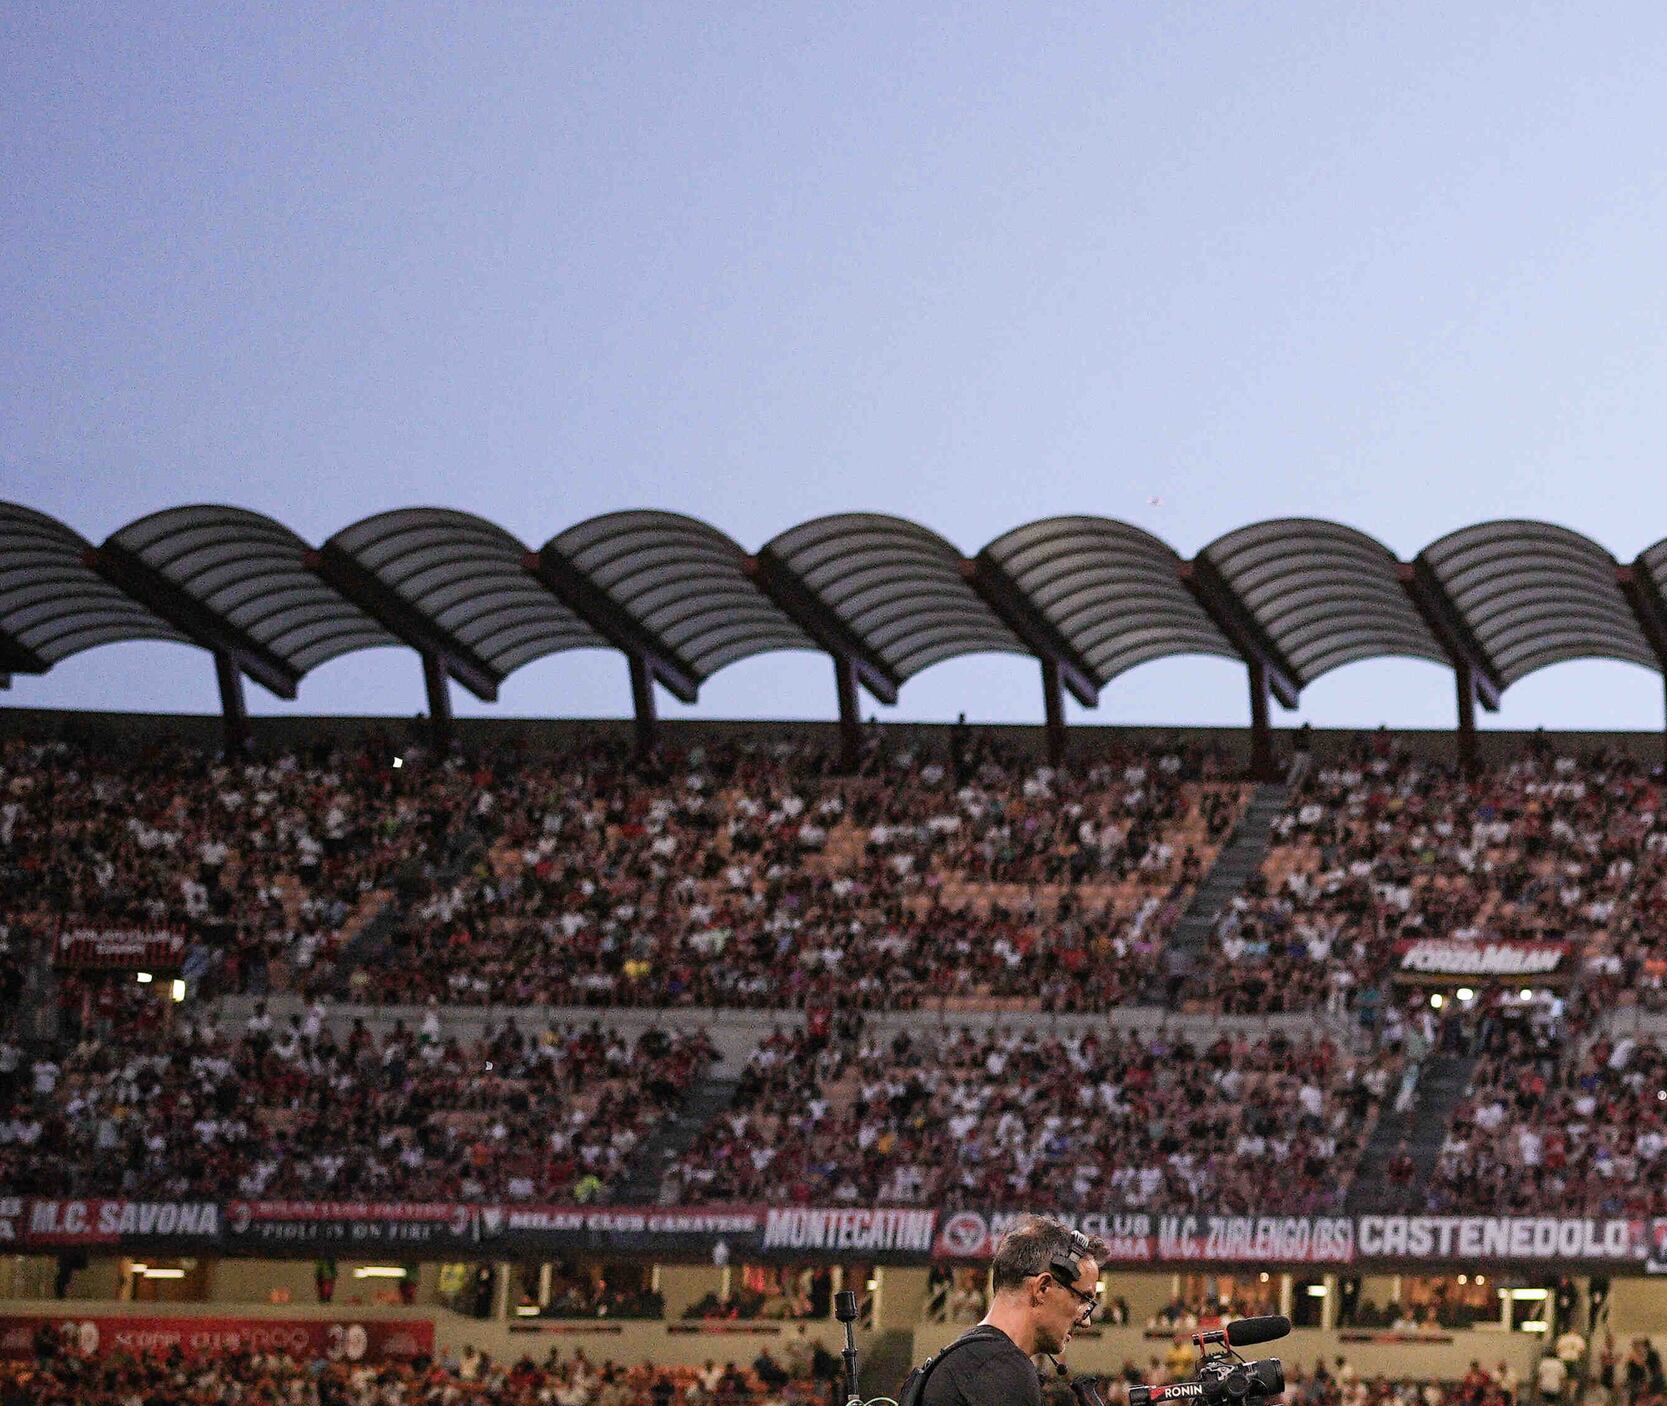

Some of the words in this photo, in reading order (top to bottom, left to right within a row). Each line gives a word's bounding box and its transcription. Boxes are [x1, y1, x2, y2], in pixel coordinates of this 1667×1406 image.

[31, 1201, 91, 1234] M.C.
[98, 1201, 219, 1235] SAVONA
[765, 1208, 935, 1251] MONTECATINI
[1082, 1214, 1151, 1237] CLUB
[1164, 1384, 1203, 1399] RONIN
